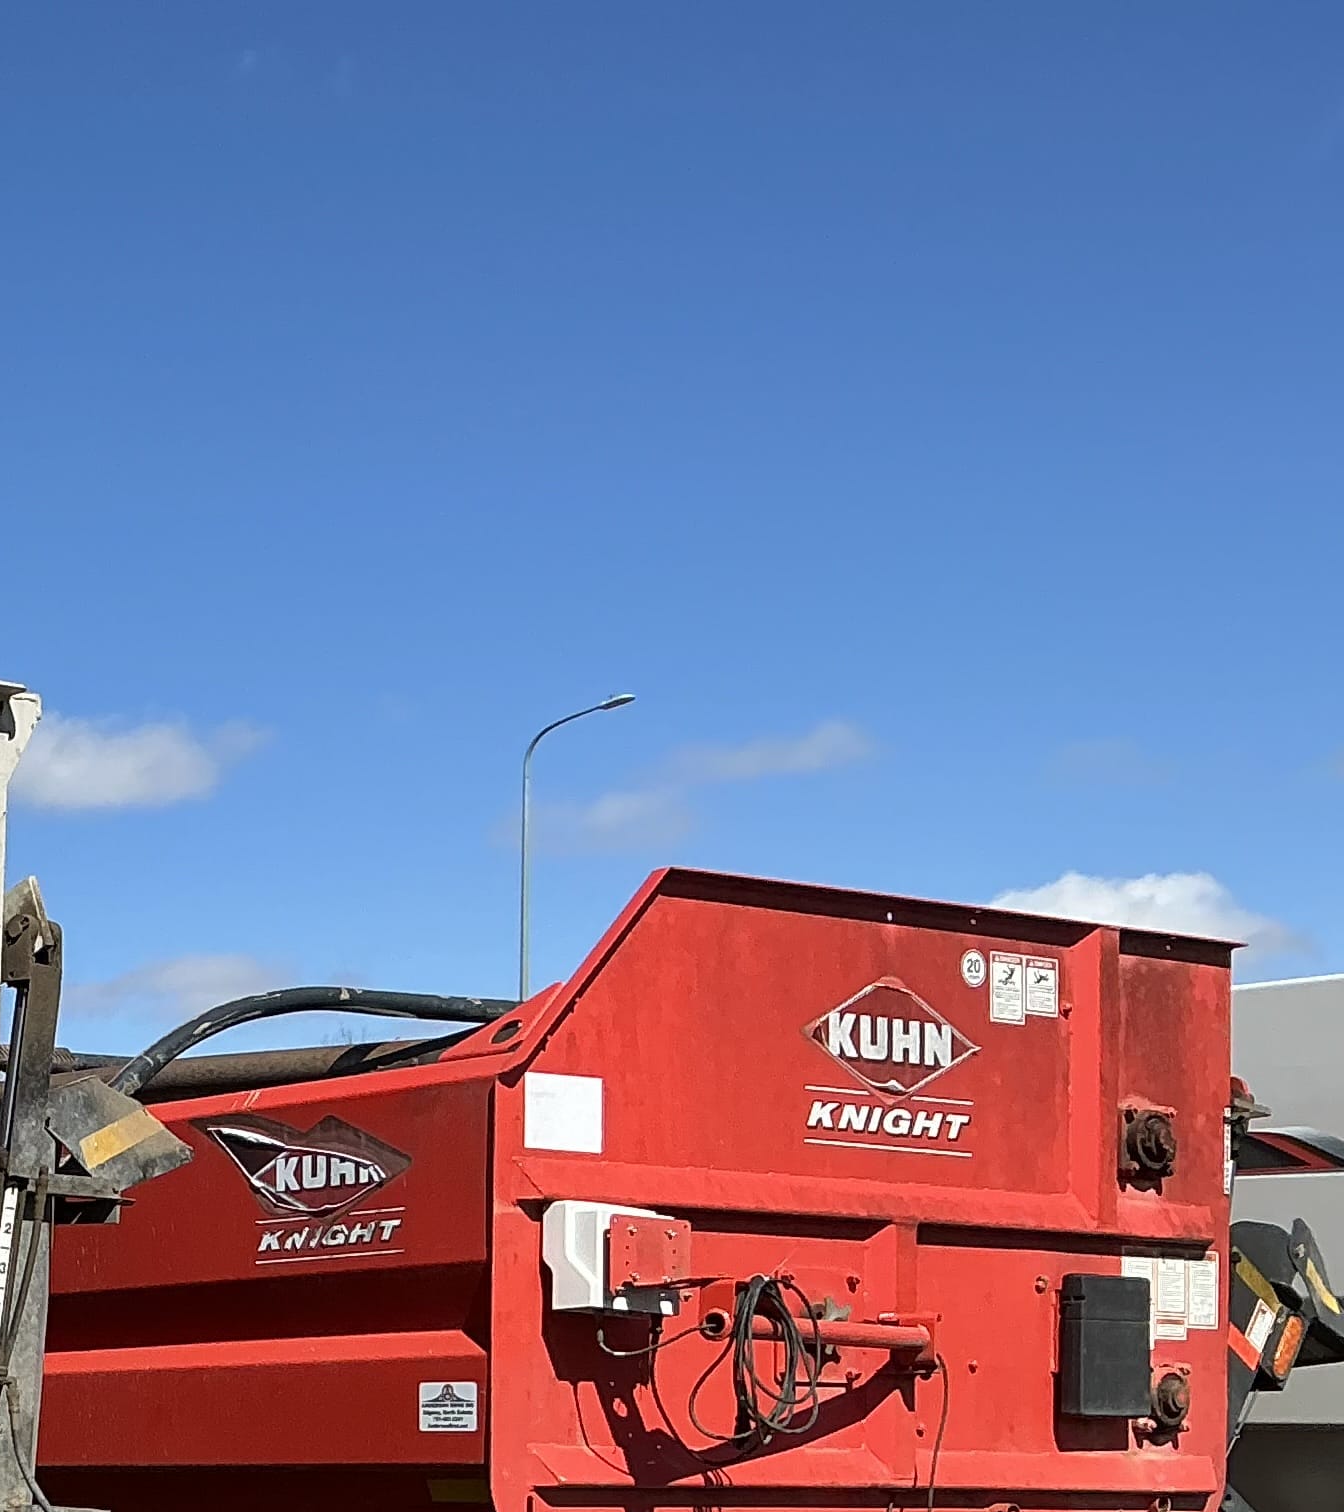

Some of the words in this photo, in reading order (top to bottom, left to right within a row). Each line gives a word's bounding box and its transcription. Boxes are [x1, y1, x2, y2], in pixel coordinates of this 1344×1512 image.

[966, 958, 981, 973] 20
[828, 1012, 953, 1068] KUHN
[806, 1100, 971, 1141] KNIGHT
[276, 1155, 386, 1192] KUHN
[3, 1222, 12, 1234] 2
[258, 1219, 402, 1251] KNIGHT
[0, 1262, 7, 1274] 3
